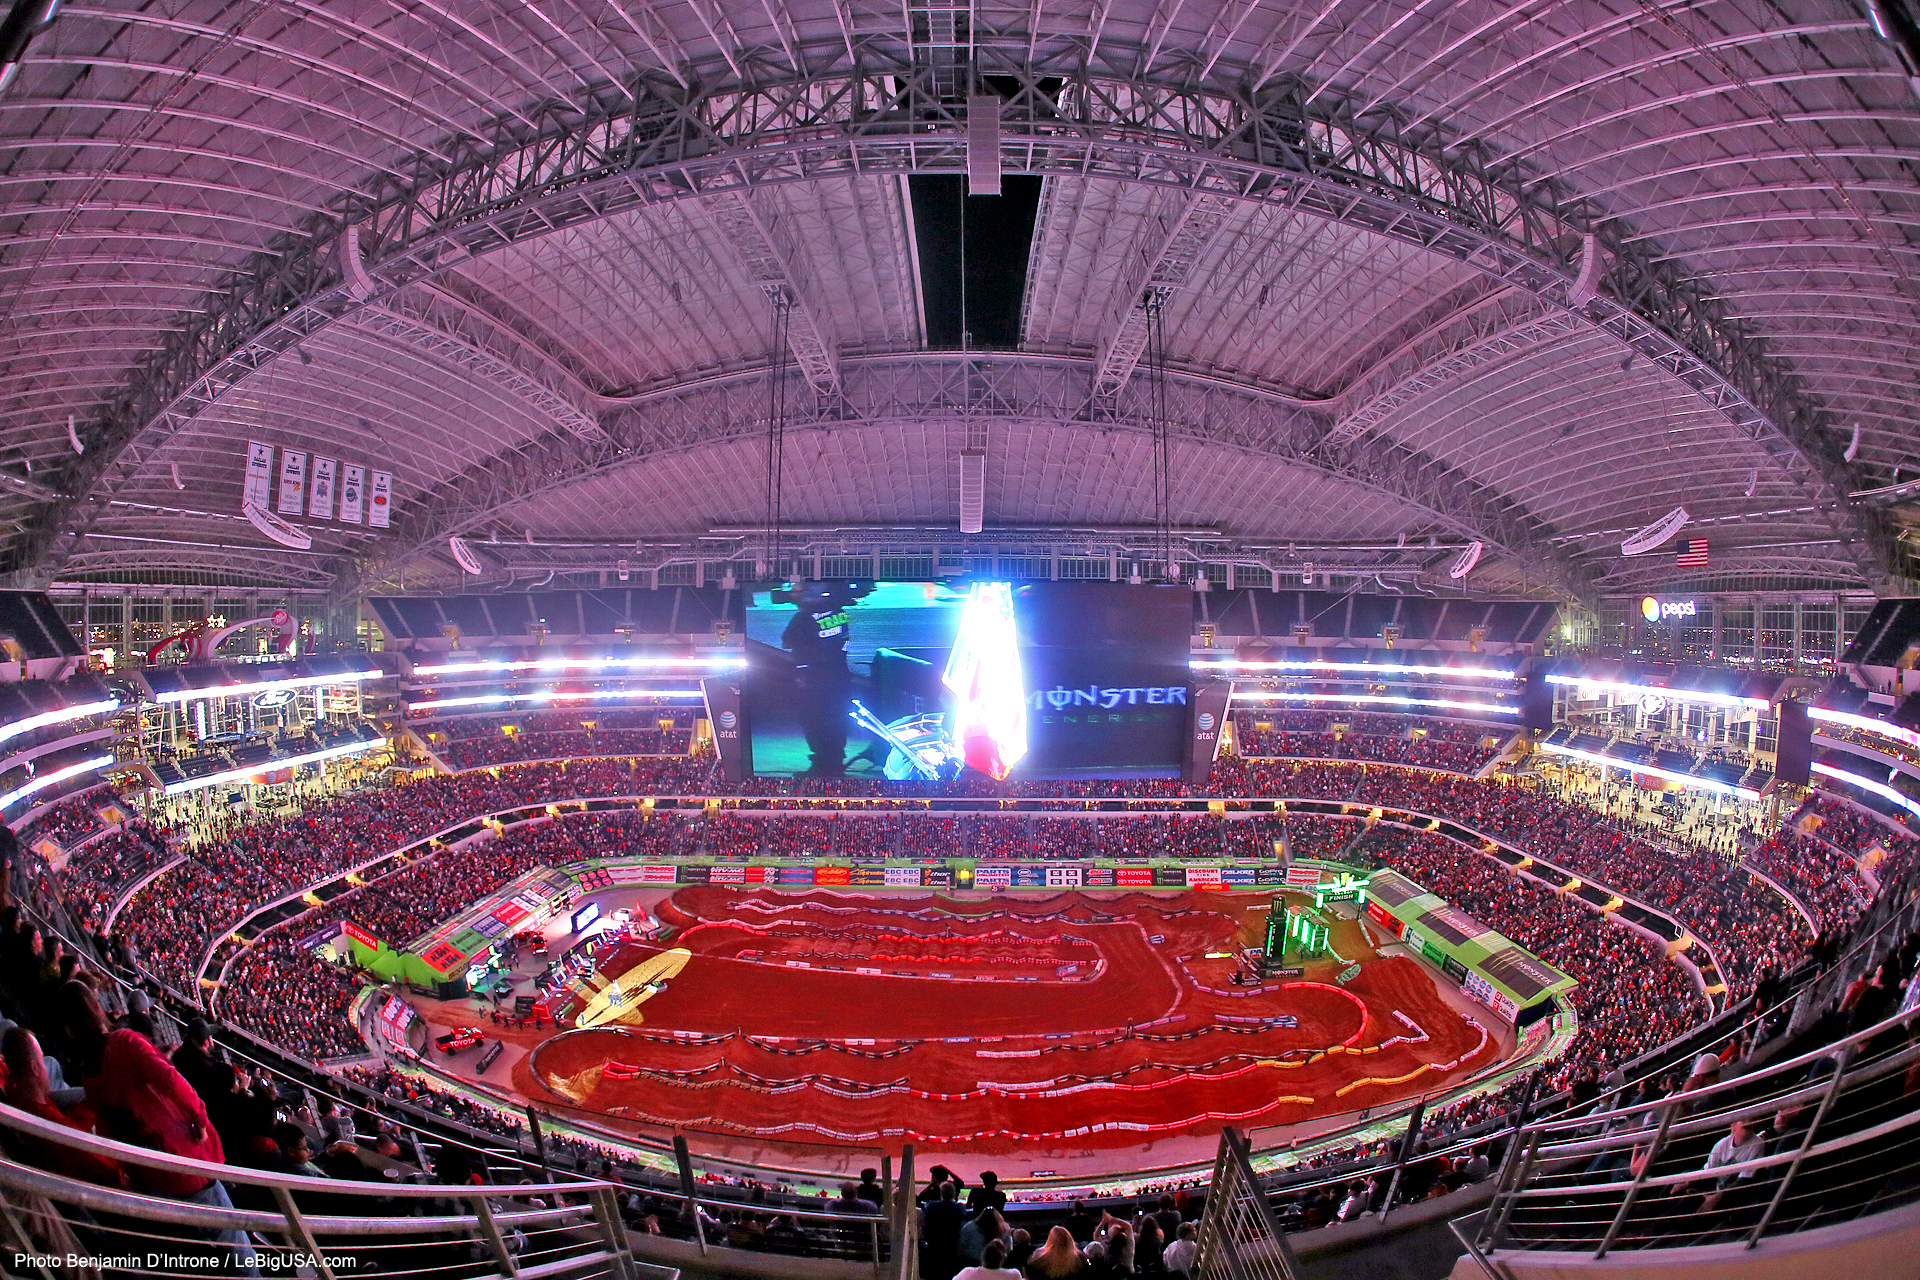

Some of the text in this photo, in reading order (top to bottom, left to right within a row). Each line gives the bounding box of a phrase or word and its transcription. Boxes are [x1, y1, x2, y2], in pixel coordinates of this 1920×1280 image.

[1661, 600, 1697, 620] pepsi
[816, 612, 848, 630] TRAC
[720, 730, 737, 738] at&t
[1196, 732, 1214, 740] at&t
[354, 930, 376, 948] TOYOTA
[1518, 960, 1552, 985] MONSTER
[384, 997, 401, 1021] 100%
[397, 1006, 415, 1030] 100%
